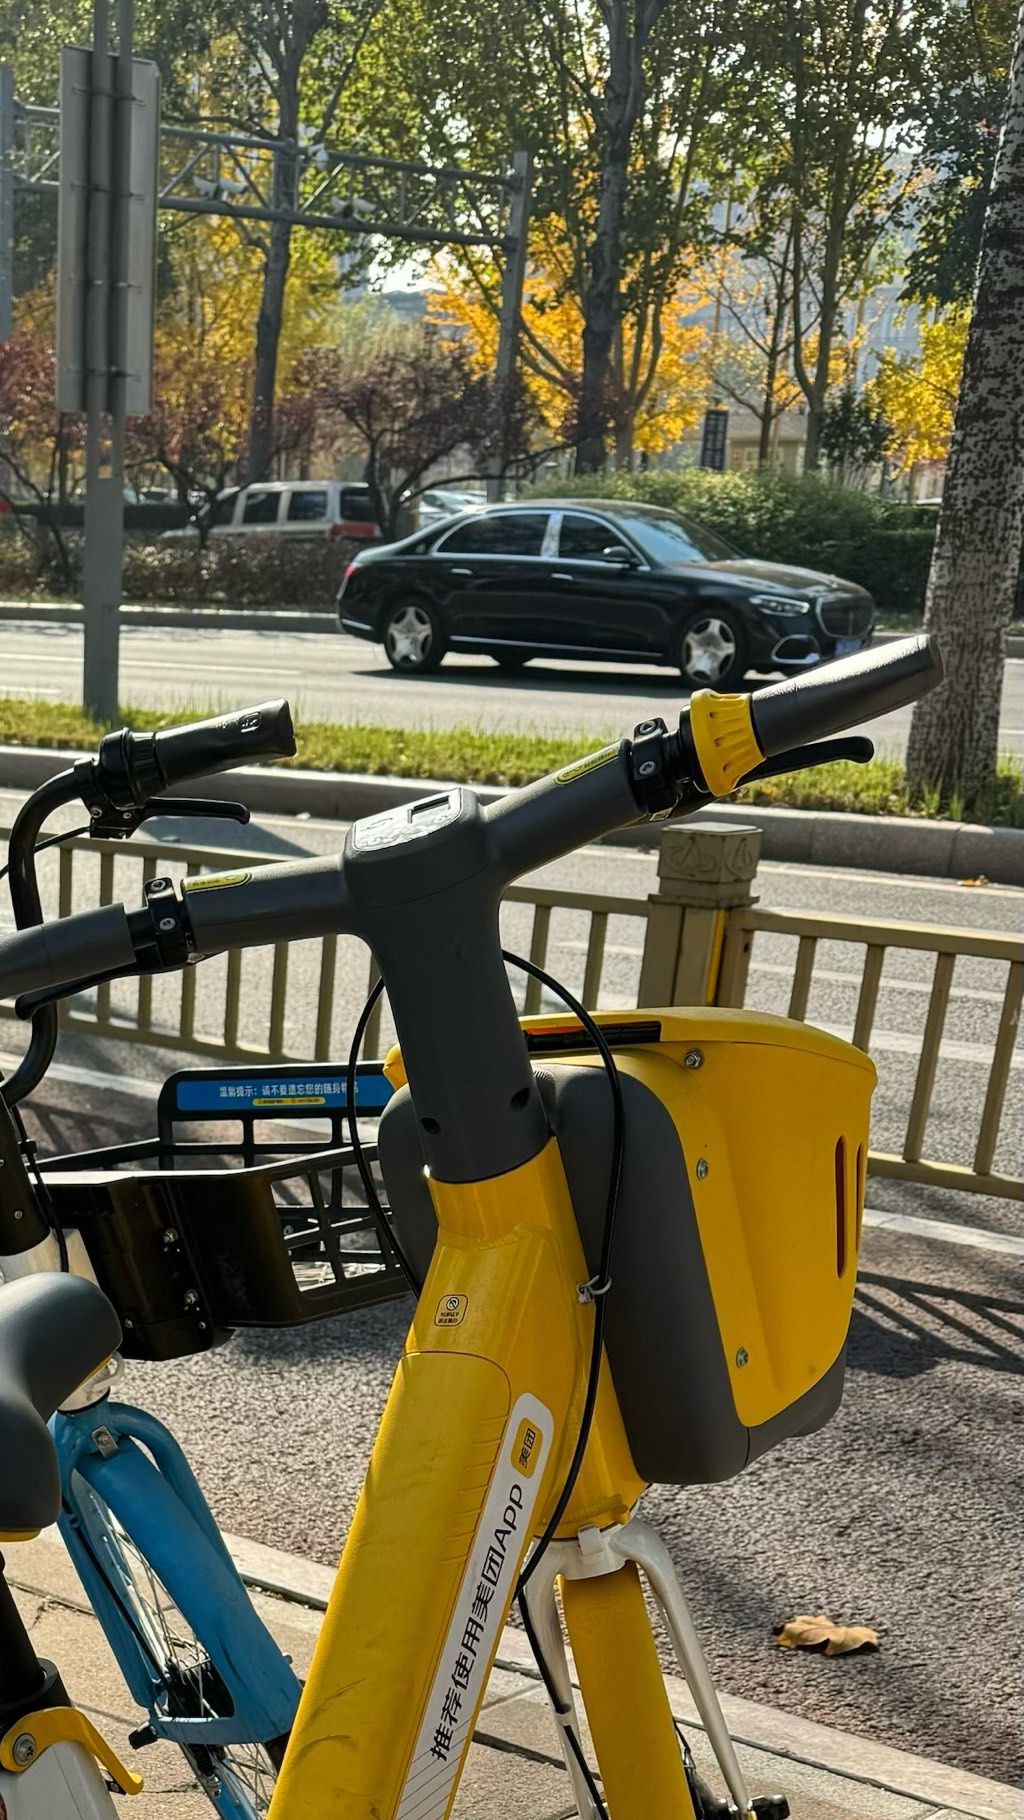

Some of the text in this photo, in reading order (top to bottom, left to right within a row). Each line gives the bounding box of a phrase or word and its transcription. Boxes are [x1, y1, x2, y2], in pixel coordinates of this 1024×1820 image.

[518, 1427, 536, 1468] 美团
[430, 1483, 523, 1762] 推荐使用美团App
